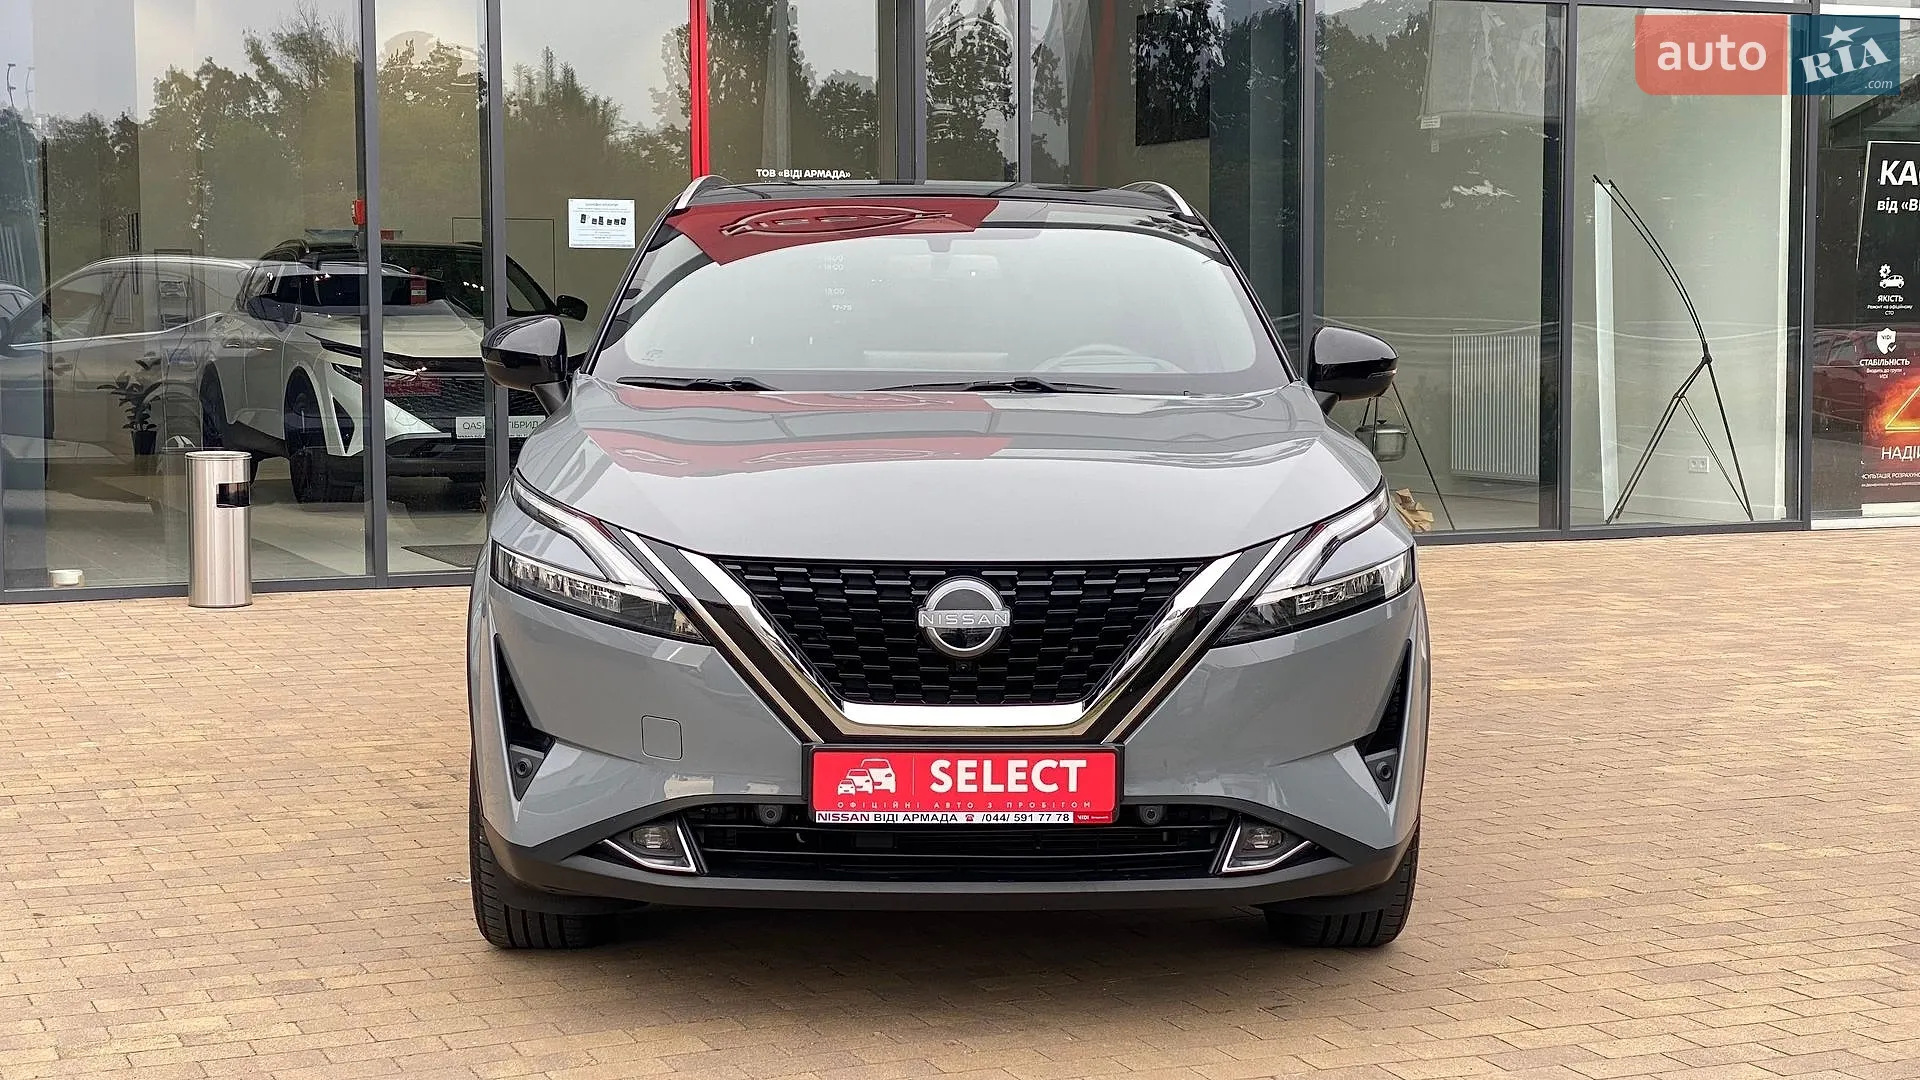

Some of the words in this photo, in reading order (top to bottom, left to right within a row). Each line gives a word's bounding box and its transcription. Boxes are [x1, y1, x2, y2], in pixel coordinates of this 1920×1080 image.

[756, 169, 776, 178] ТОВ
[1880, 160, 1920, 185] КА
[1877, 197, 1898, 213] від
[921, 613, 1008, 625] NISSAN
[930, 759, 1087, 793] SELECT
[933, 801, 975, 809] АВТО
[1006, 801, 1091, 809] ПРОБІГОМ
[817, 813, 870, 822] NISSAN
[874, 813, 898, 823] ВІДІ
[902, 813, 958, 823] АРМАДА
[982, 813, 1010, 822] /044/
[1013, 813, 1034, 822] 591
[1038, 813, 1051, 822] 77
[1056, 813, 1070, 822] 78
